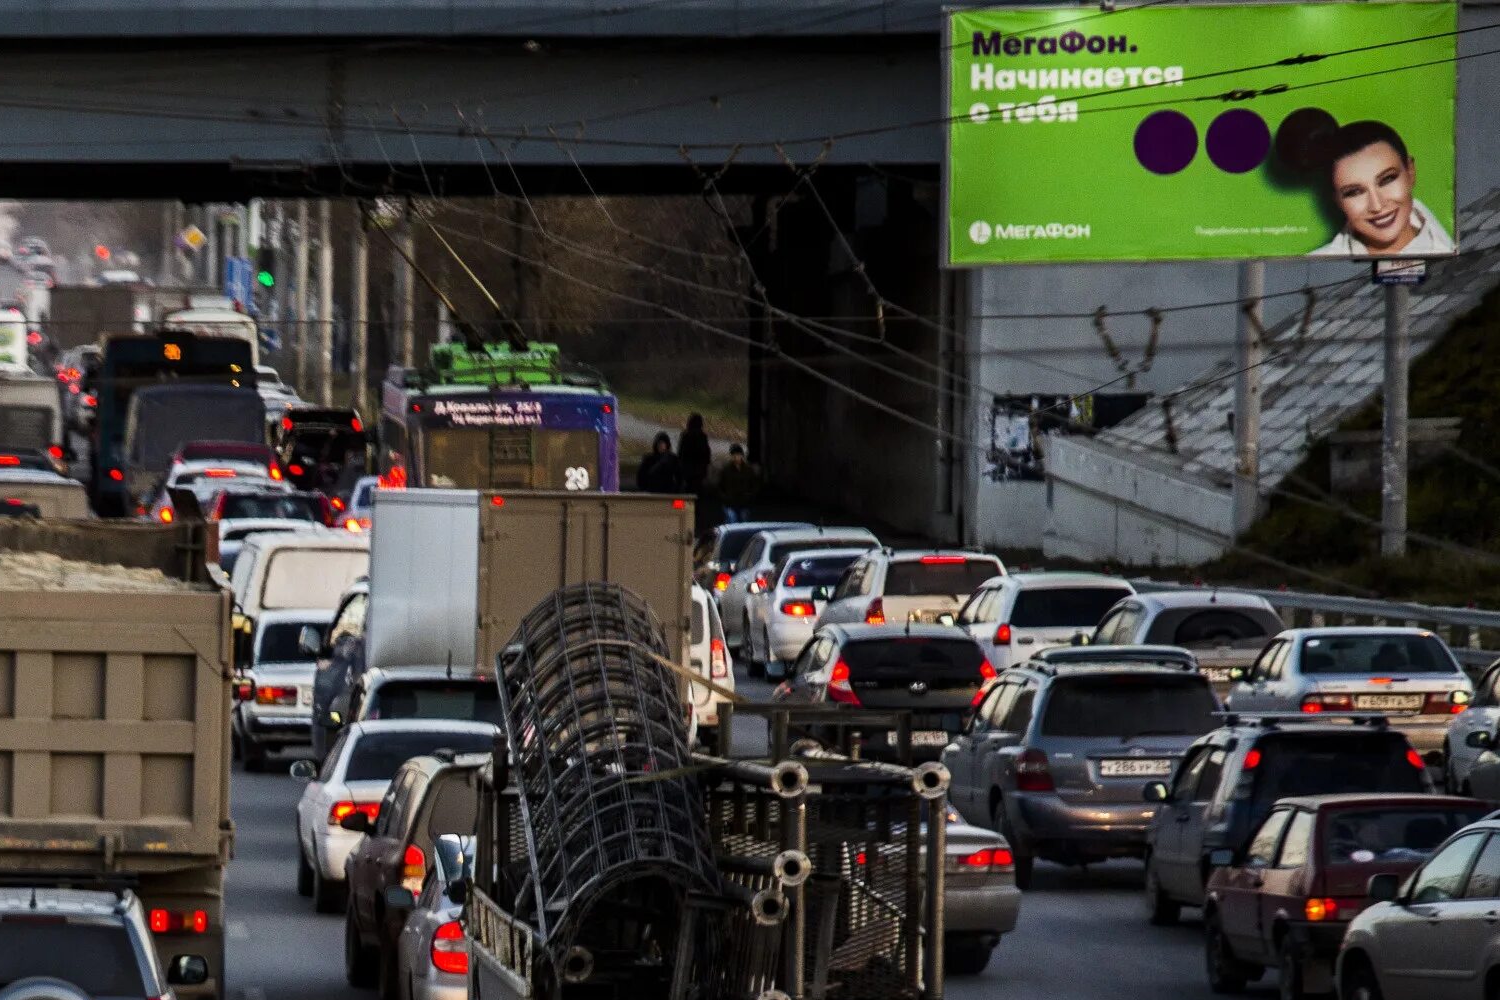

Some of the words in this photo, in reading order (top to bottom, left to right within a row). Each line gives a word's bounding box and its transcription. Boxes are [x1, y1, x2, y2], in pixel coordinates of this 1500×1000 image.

[972, 30, 1138, 56] МегаФон.
[970, 63, 1184, 89] Начинается
[969, 102, 991, 123] с
[998, 95, 1078, 123] тебя
